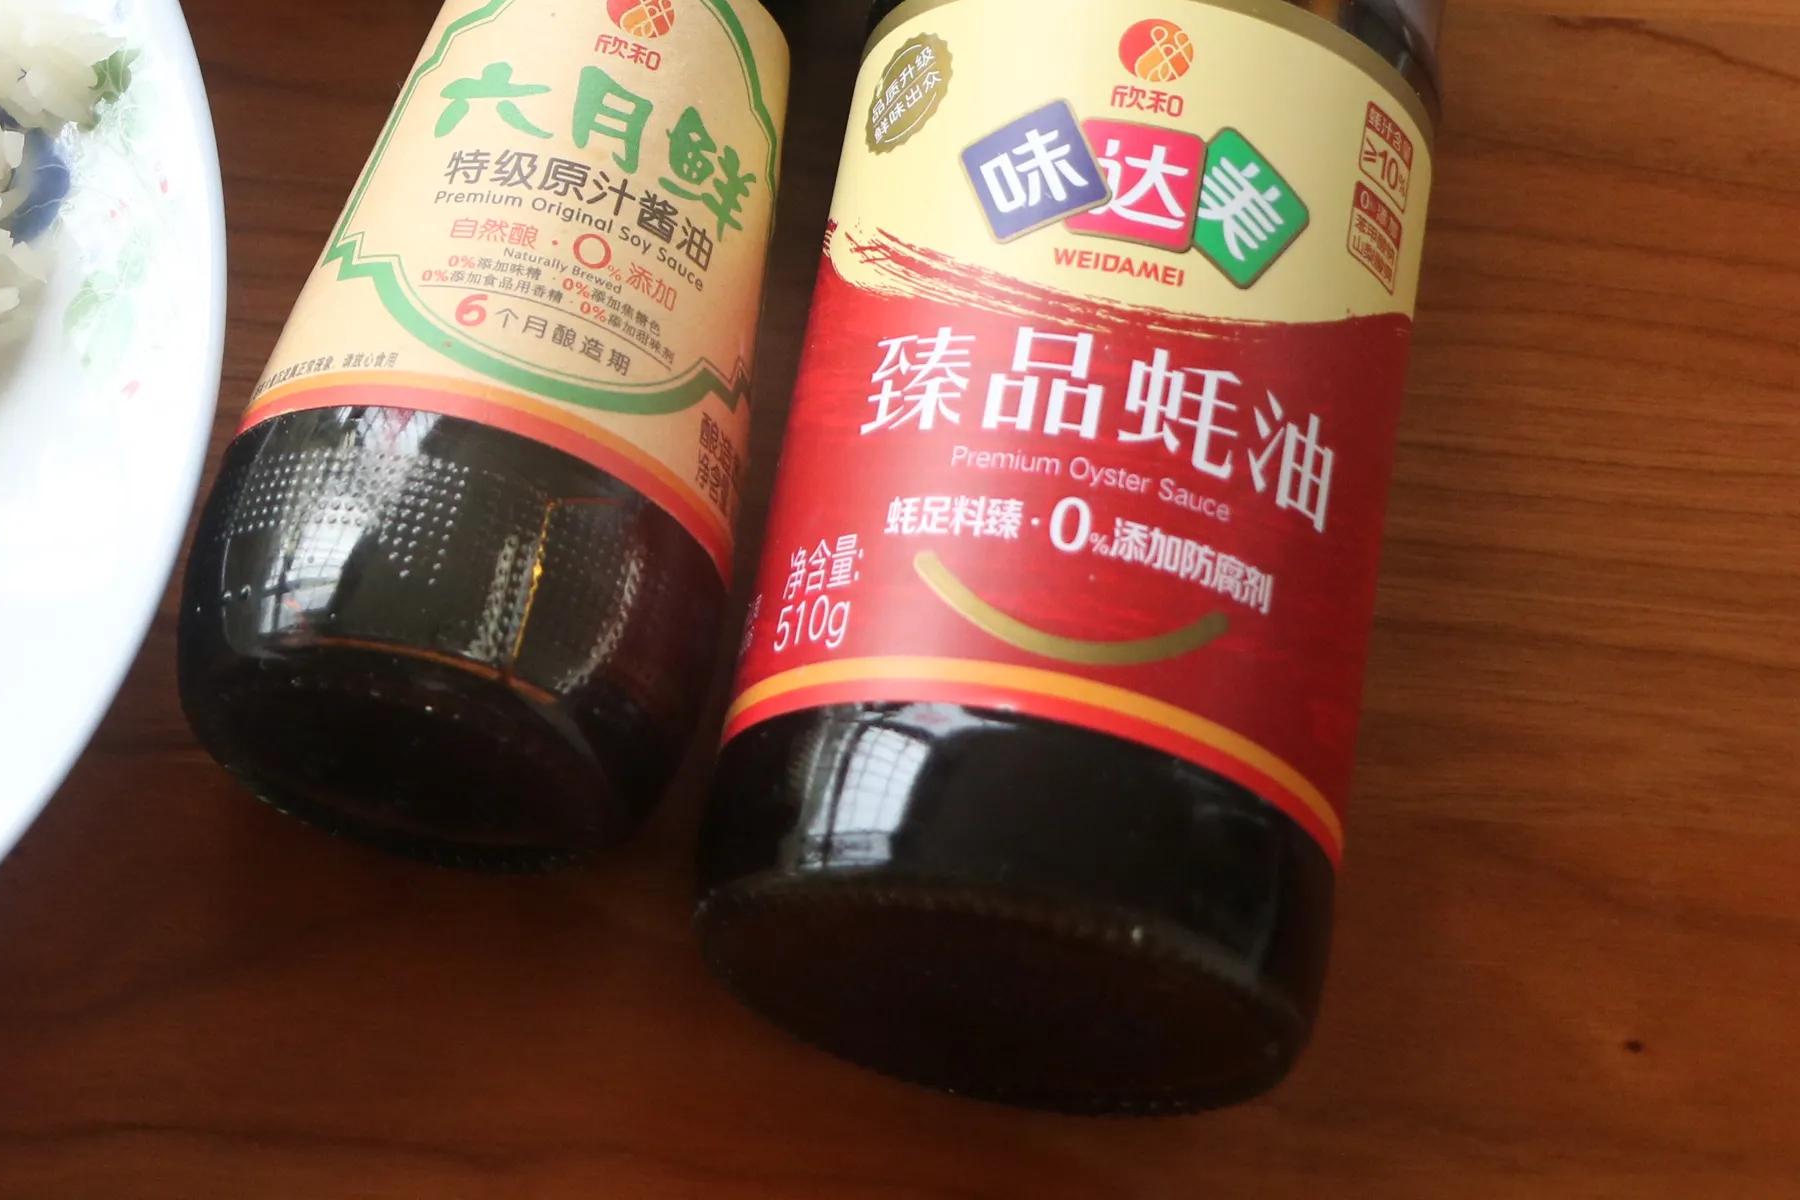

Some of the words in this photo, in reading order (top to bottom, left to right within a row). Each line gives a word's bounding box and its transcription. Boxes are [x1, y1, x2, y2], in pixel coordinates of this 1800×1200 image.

[594, 34, 662, 71] 欣和
[872, 46, 935, 124] 品质升级
[874, 71, 942, 144] 鲜味出众
[1110, 85, 1184, 117] 欣和
[434, 61, 756, 242] 六月鲜
[1367, 108, 1413, 167] 蚝汁含
[444, 149, 714, 272] 特级原汁酱油
[979, 129, 1285, 262] 味达美
[434, 189, 523, 208] Premium
[532, 197, 613, 233] Original
[620, 226, 651, 255] Soy
[656, 247, 704, 291] Sauce
[448, 255, 542, 281] 0%添加味精
[450, 217, 539, 250] 自然酿
[1053, 248, 1185, 287] WEIDAMEI
[503, 247, 568, 273] Naturally
[571, 265, 622, 295] Brewed
[455, 293, 631, 376] 6个月酿造期
[860, 326, 1334, 533] 臻品蚝油
[950, 445, 1061, 477] Premium
[1069, 456, 1152, 496] Oyster
[1158, 478, 1232, 523] Sauce
[783, 534, 864, 600] 净含量:
[773, 594, 851, 652] 510g
